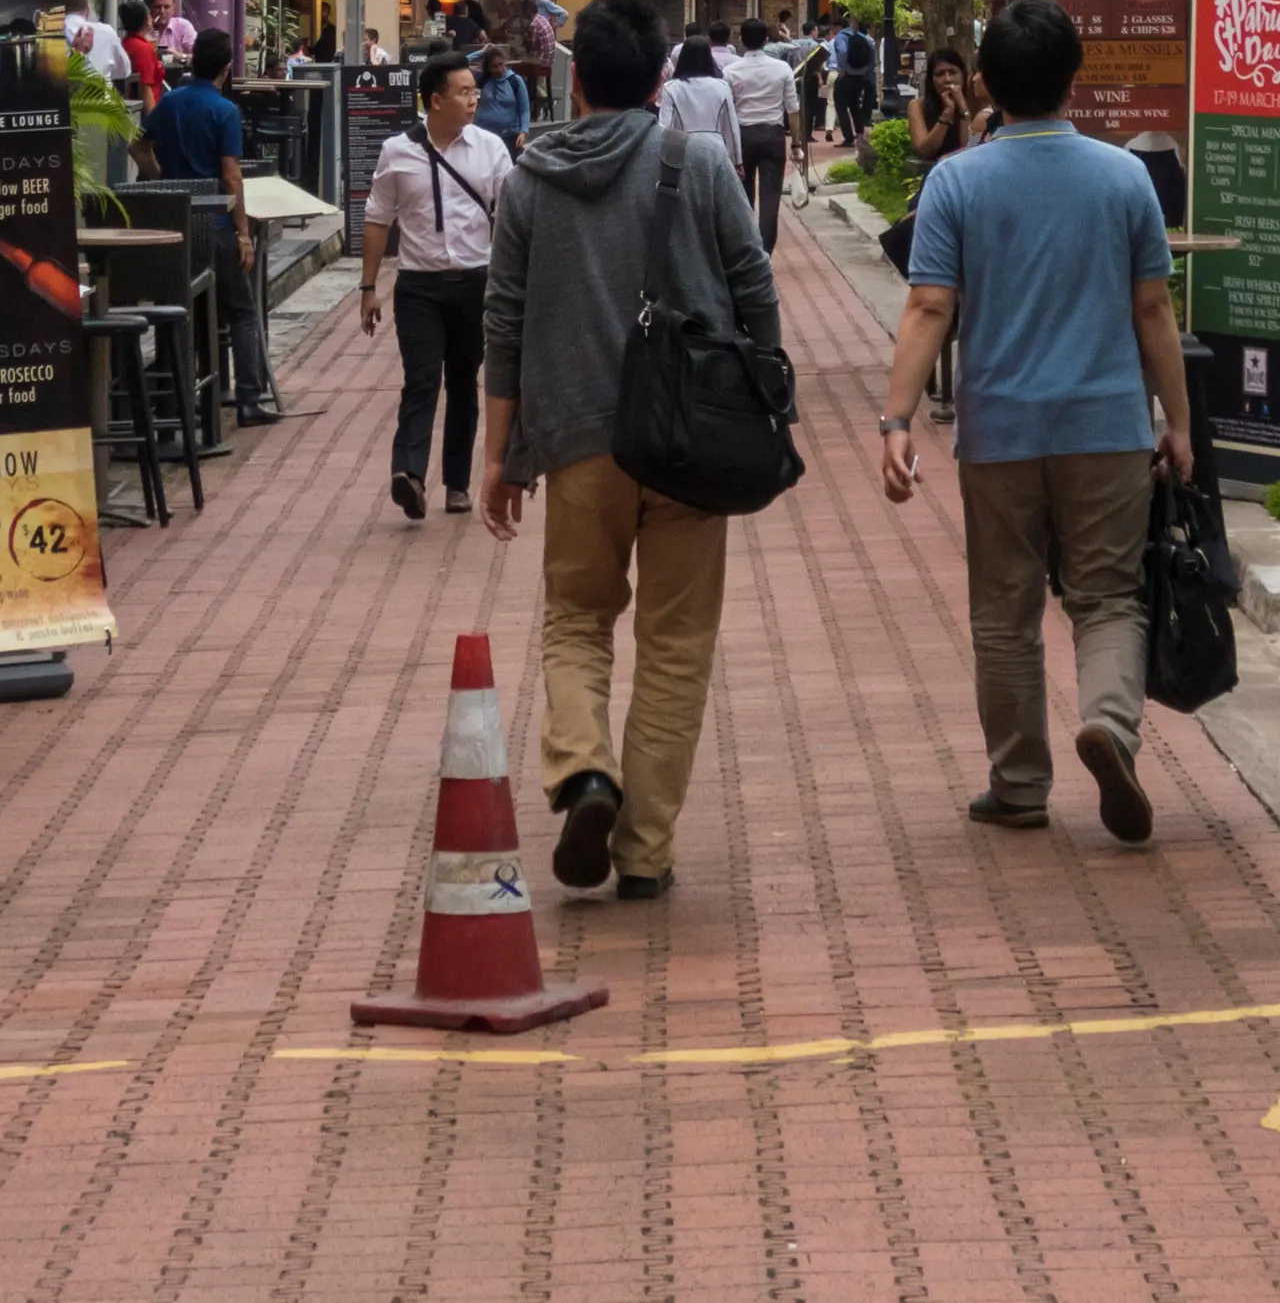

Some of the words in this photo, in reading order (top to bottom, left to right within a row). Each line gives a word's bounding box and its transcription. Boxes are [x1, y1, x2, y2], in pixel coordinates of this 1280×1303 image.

[1122, 15, 1128, 24] 2
[1131, 15, 1174, 24] GLASSES
[1120, 26, 1129, 34] &
[1131, 26, 1160, 34] CHIPS
[1093, 90, 1131, 103] WINE
[1240, 91, 1280, 109] MARCH
[12, 113, 60, 128] LOUNGE
[1093, 109, 1108, 118] OF
[1108, 109, 1142, 118] HOUSE
[1144, 109, 1170, 118] WINE
[1231, 124, 1259, 138] SPECIAL
[1221, 142, 1237, 151] AND
[22, 178, 50, 194] BEER
[21, 198, 48, 215] food
[1235, 216, 1256, 228] IRISH
[1257, 217, 1280, 230] BEERS
[1223, 276, 1245, 290] IRISH
[8, 387, 36, 403] food
[6, 588, 29, 600] wine
